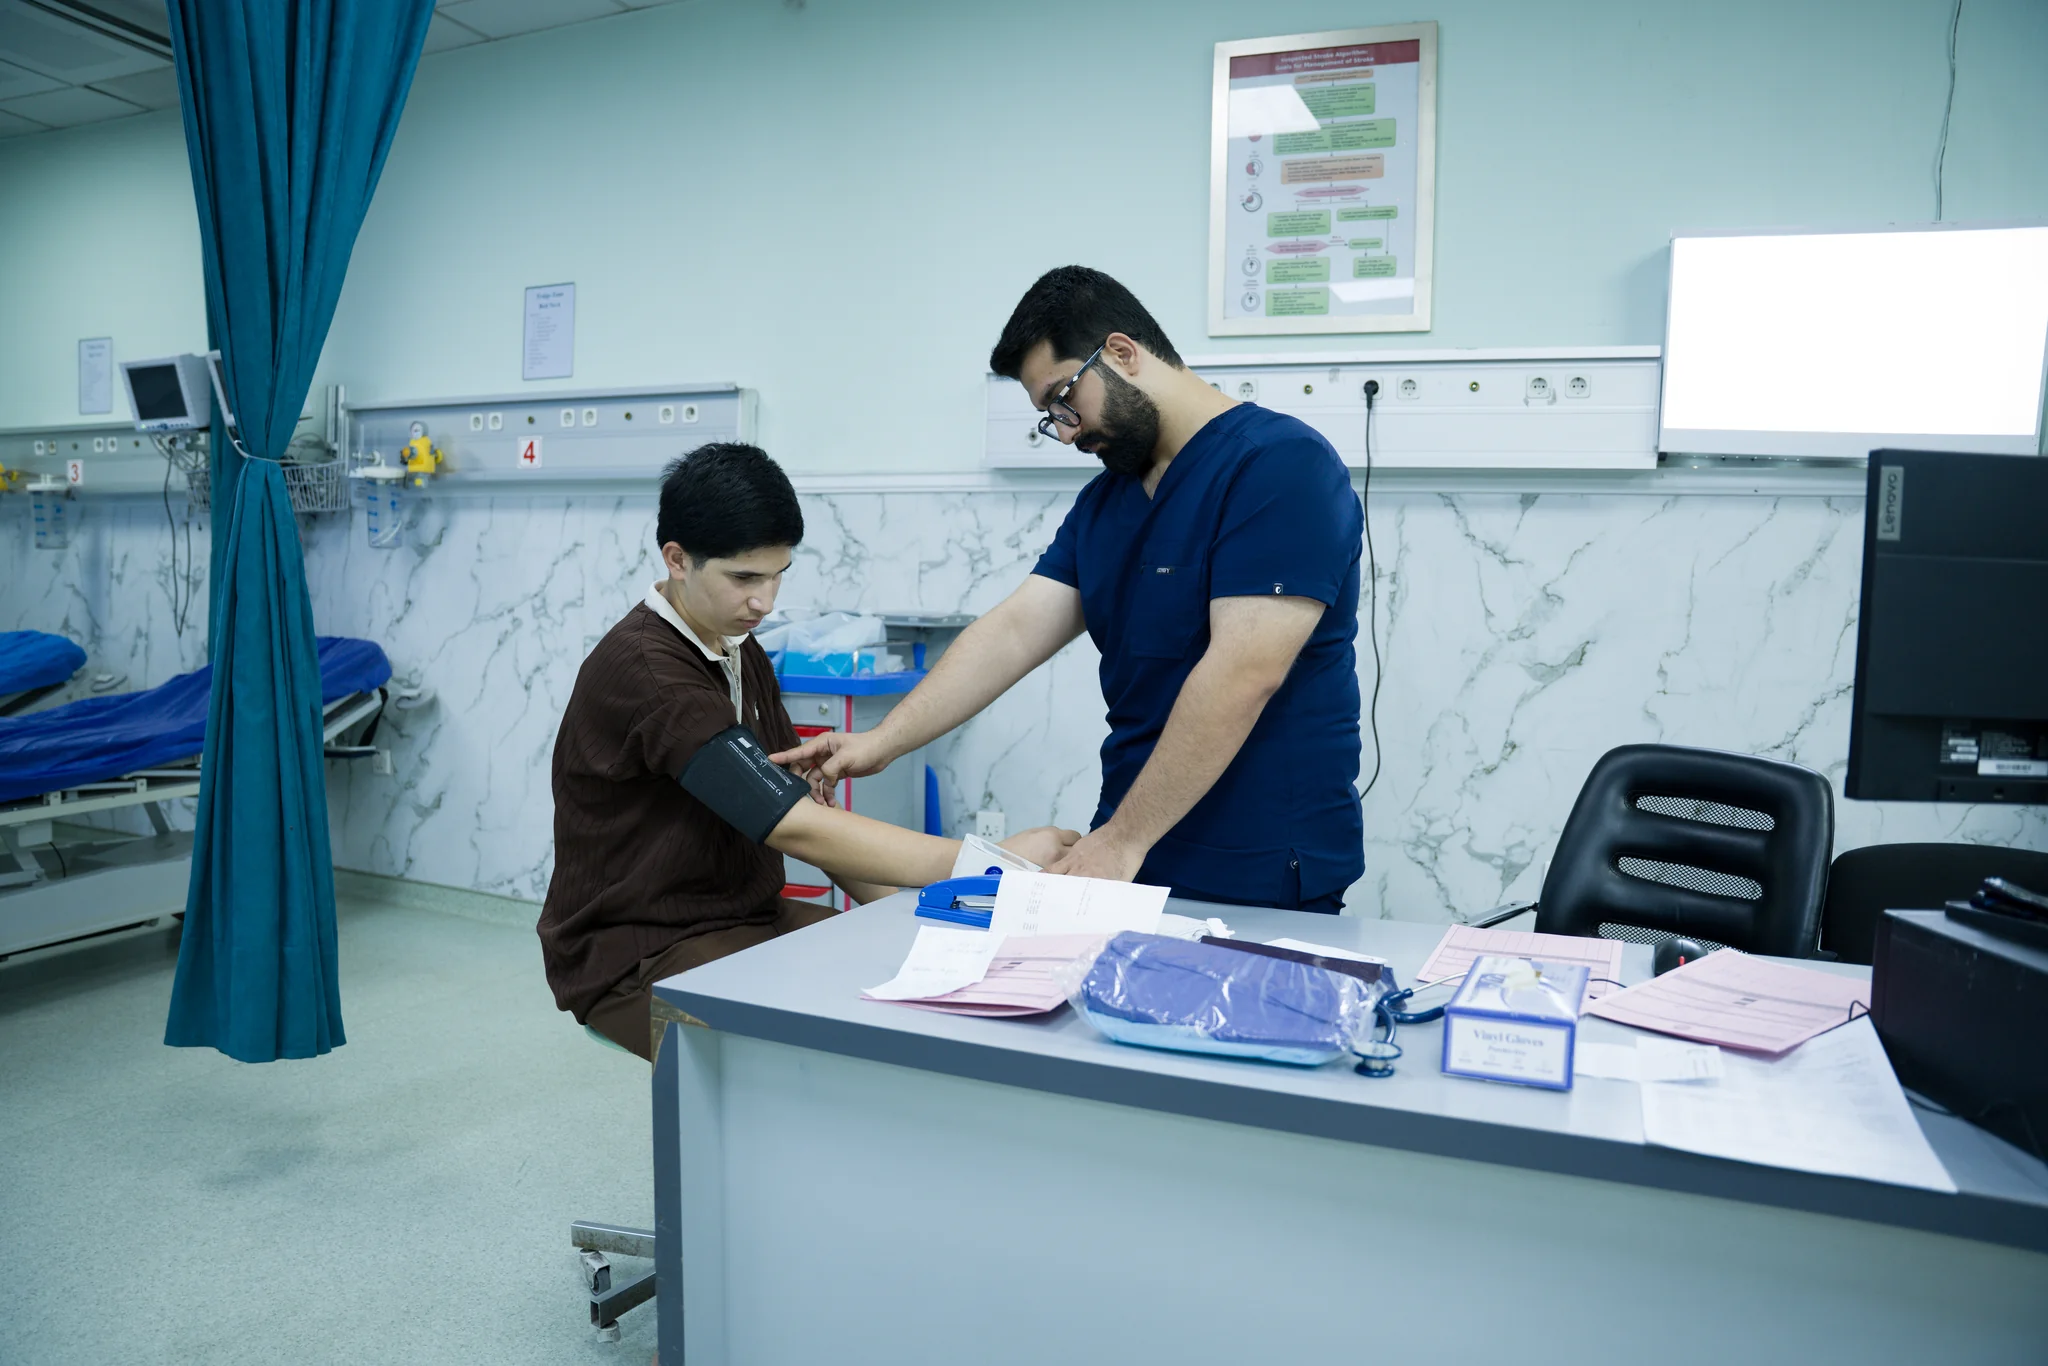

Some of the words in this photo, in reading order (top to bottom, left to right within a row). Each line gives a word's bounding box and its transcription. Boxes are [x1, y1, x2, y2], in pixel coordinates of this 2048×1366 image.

[1304, 60, 1344, 68] Management
[523, 440, 536, 464] 4
[71, 463, 79, 482] 3
[1882, 472, 1897, 533] Lenovo
[1473, 1028, 1503, 1044] Vinyl
[1505, 1033, 1544, 1047] Gloves
